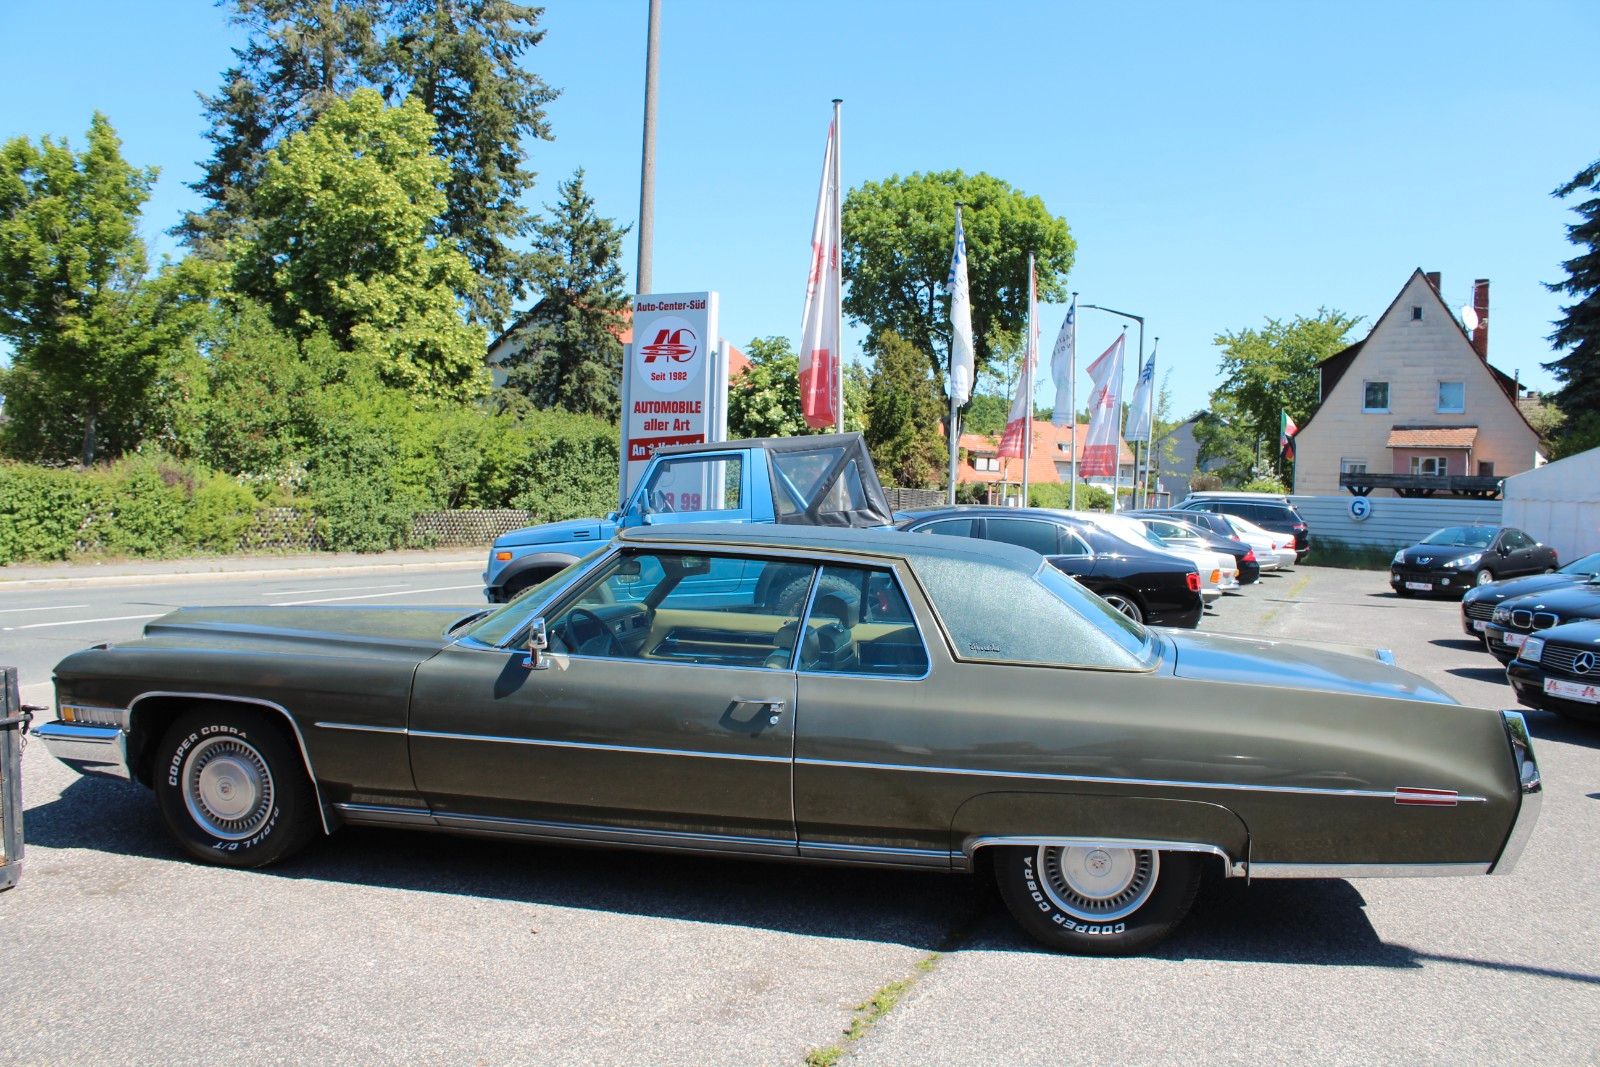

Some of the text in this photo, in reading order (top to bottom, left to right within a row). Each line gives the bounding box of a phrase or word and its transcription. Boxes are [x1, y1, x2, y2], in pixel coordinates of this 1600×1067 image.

[636, 300, 706, 312] Auto-Center-Süd
[651, 371, 687, 381] Seit 1982
[633, 401, 701, 414] AUTOMOBILE
[643, 418, 690, 431] aller Art
[632, 444, 646, 456] An
[1352, 501, 1365, 516] G
[168, 725, 247, 787] COOPER COBRA
[242, 806, 280, 848] RADIAL
[1024, 856, 1125, 935] COBRA COOPER
